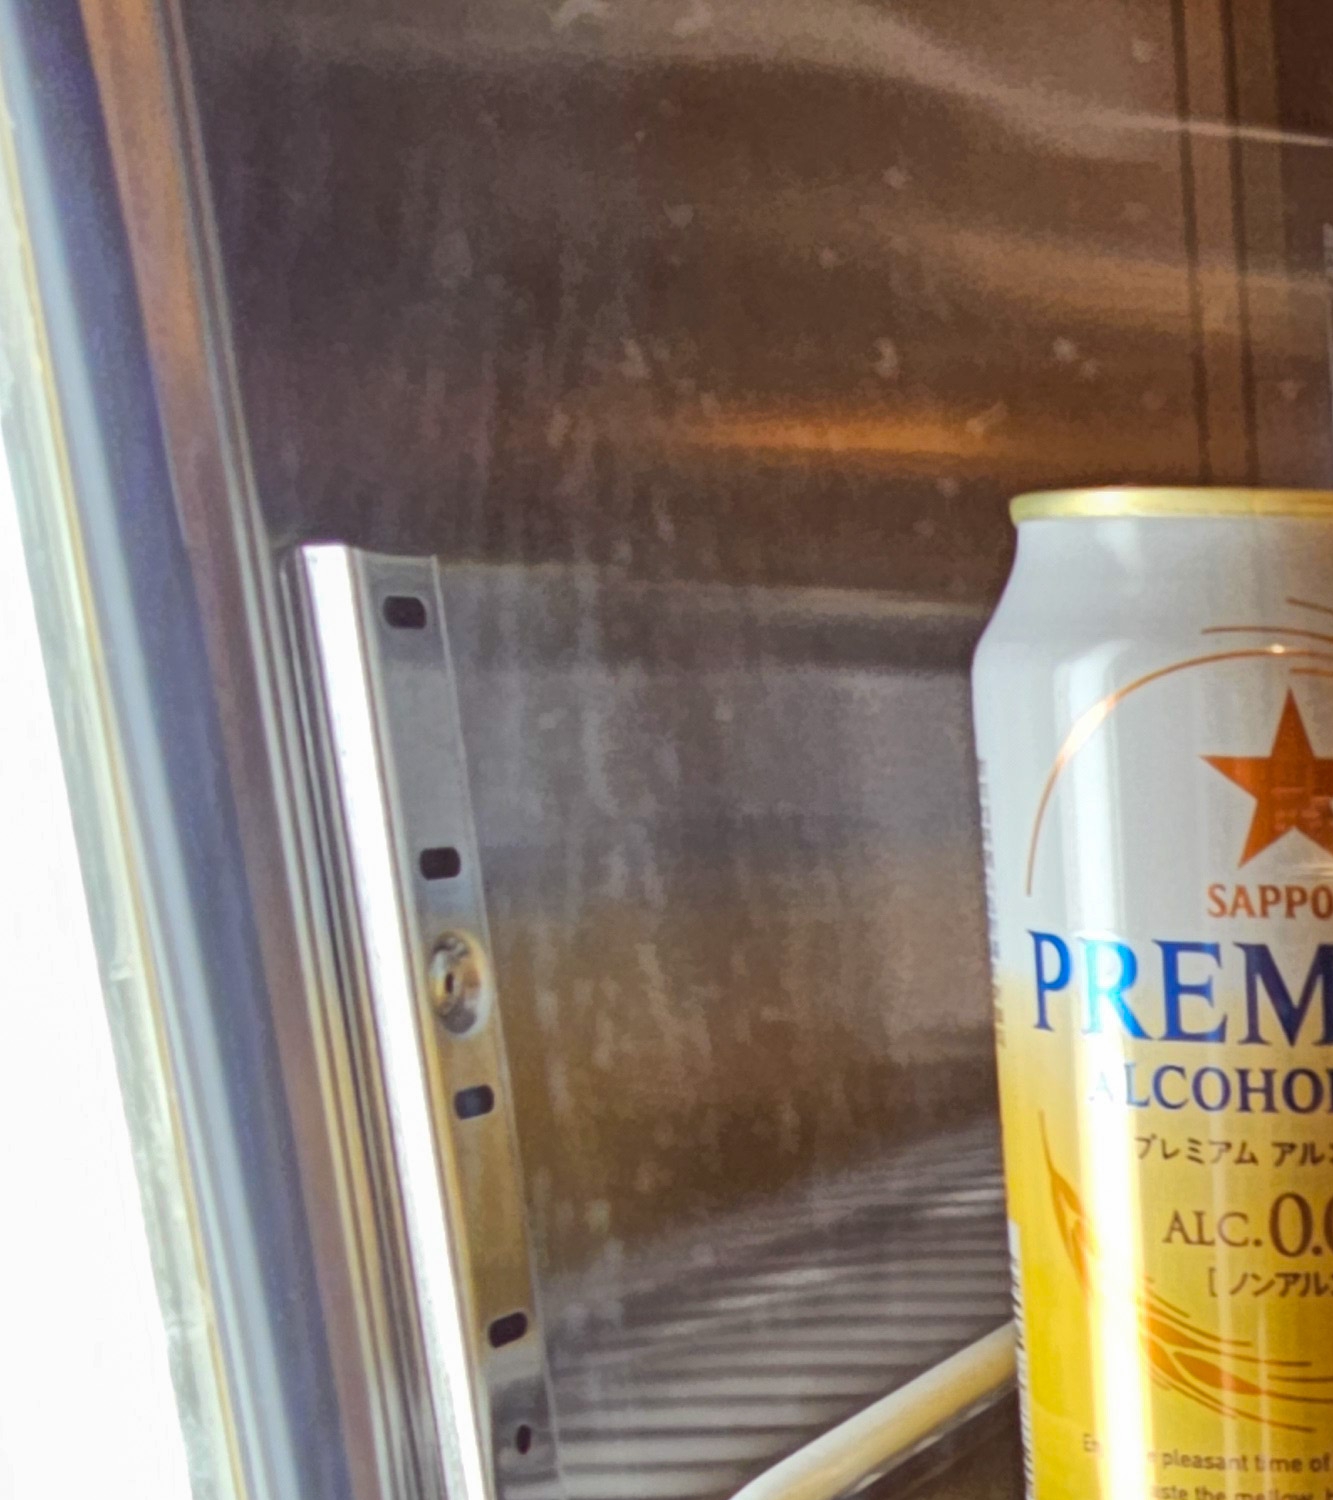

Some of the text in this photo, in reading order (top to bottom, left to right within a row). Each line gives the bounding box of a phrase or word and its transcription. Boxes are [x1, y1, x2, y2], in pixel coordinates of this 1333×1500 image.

[1135, 1134, 1259, 1167] プレミアム
[1254, 1454, 1304, 1473] tme
